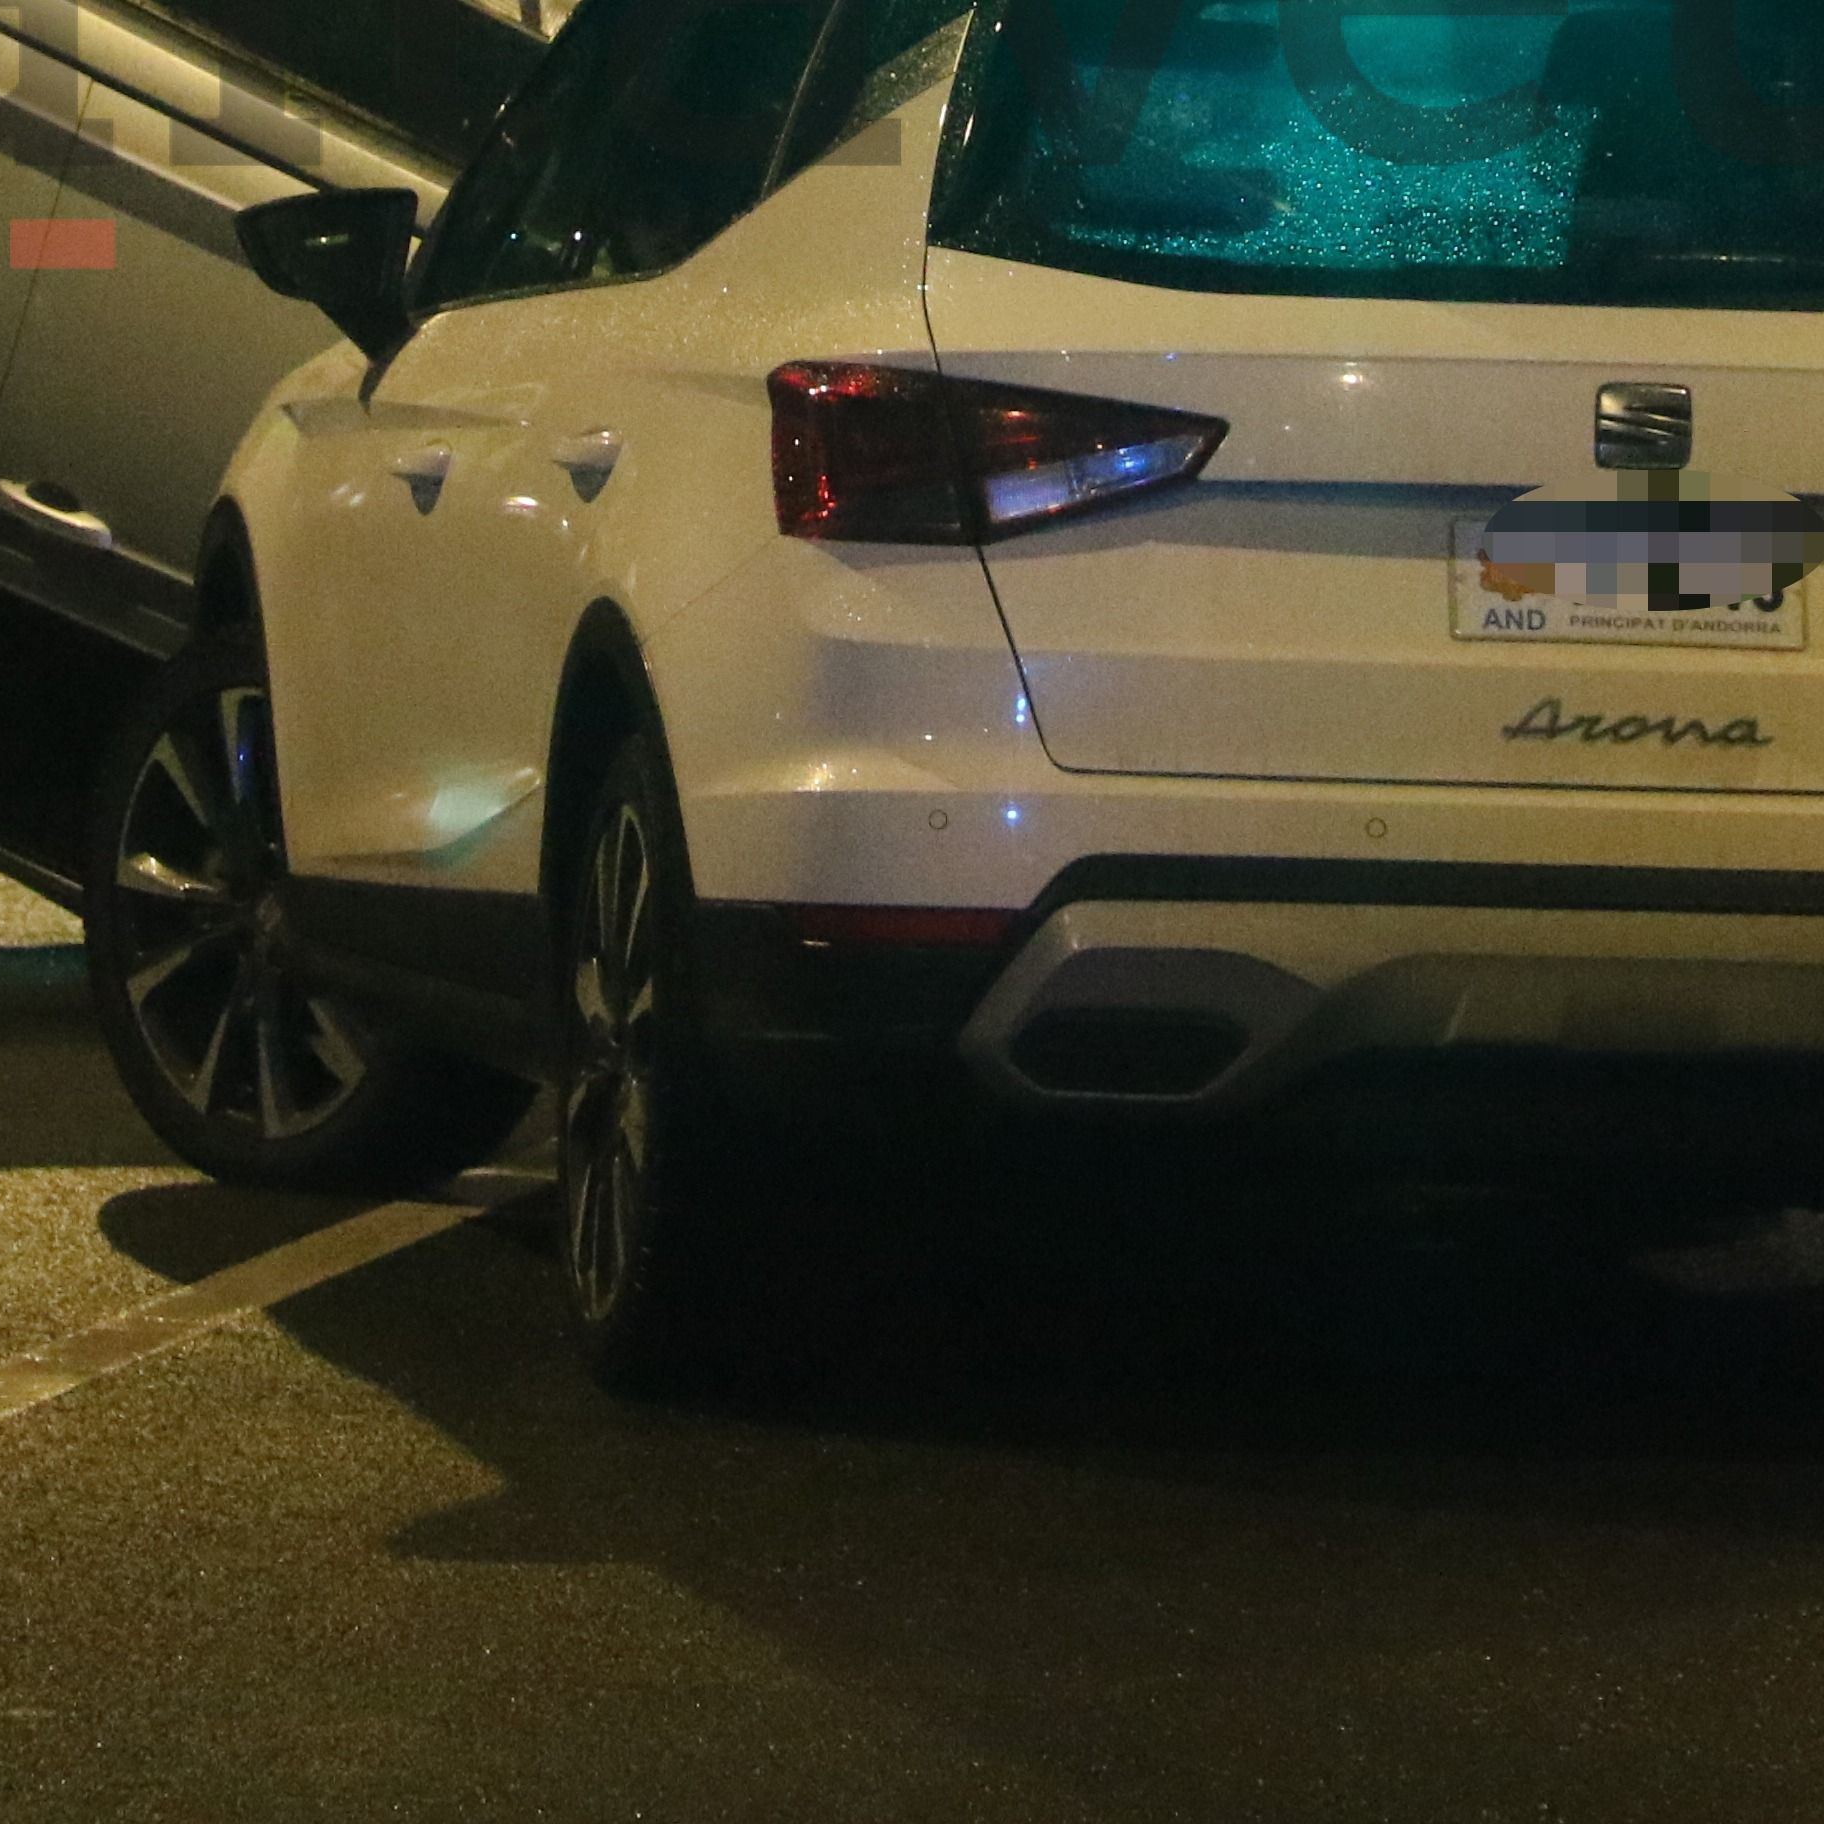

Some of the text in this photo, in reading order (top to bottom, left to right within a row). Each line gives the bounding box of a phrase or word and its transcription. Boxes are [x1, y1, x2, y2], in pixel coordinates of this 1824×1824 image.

[1482, 608, 1783, 634] AND PRINCIPAT D'ANDORRA
[1499, 696, 1775, 747] Arona
